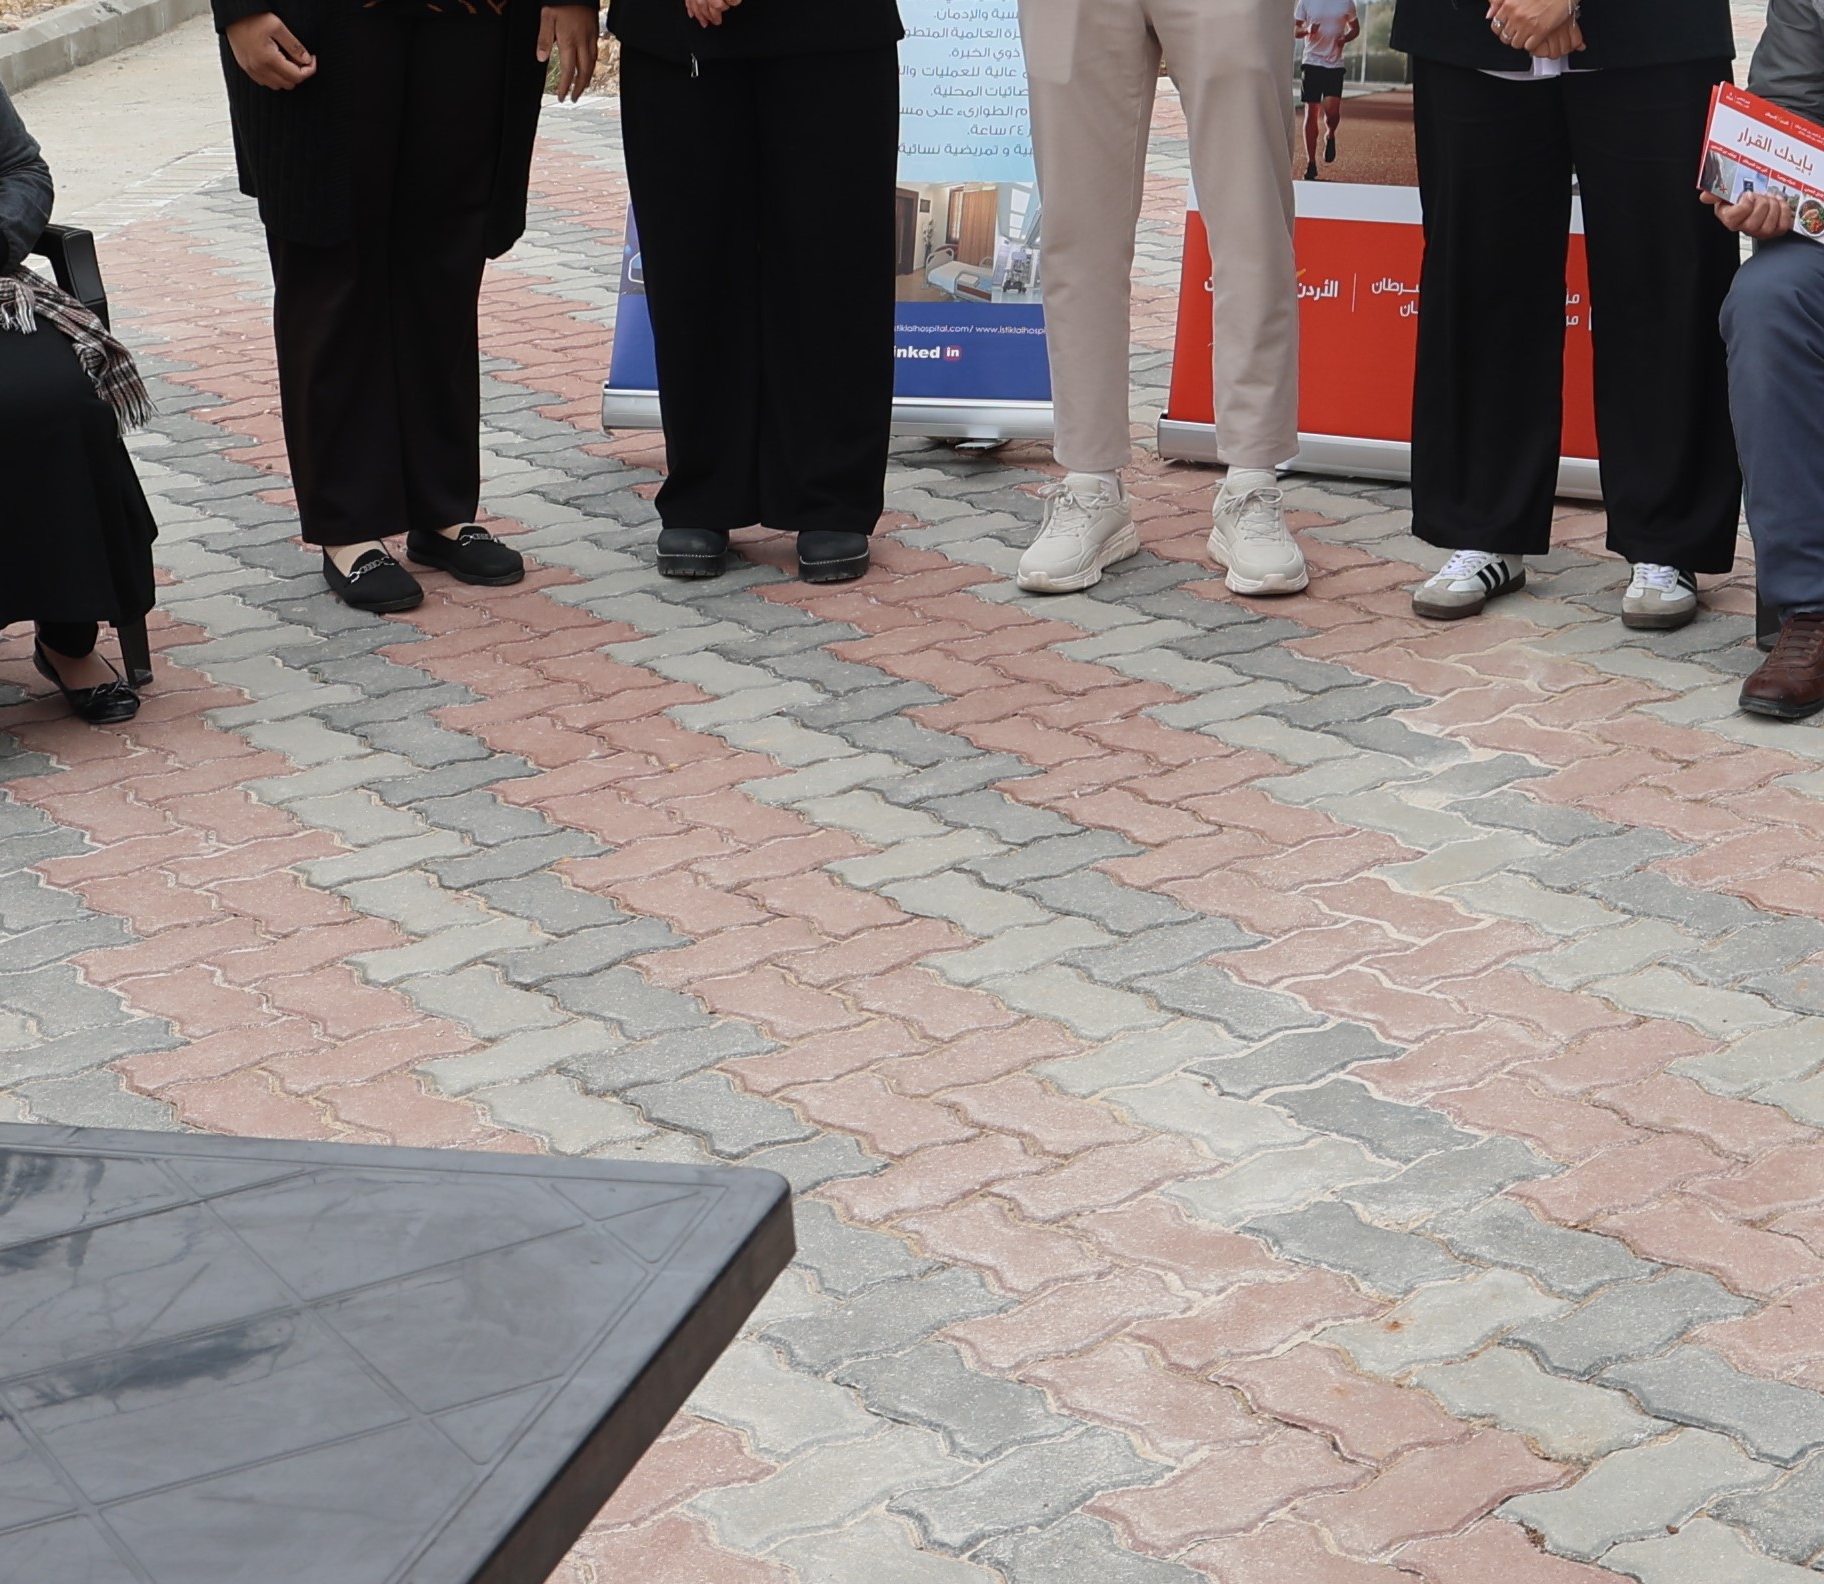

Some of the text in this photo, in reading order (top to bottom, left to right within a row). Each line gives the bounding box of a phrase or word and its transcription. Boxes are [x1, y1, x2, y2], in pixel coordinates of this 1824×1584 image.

[951, 27, 1002, 40] العالمية
[993, 48, 1020, 61] ذوي
[922, 66, 980, 78] للعمليات
[985, 66, 1017, 78] عالية
[926, 105, 954, 118] على
[1737, 127, 1772, 153] القرار
[944, 144, 998, 156] تمريضية
[1774, 146, 1813, 176] بإيدك
[1297, 278, 1339, 301] الأردن
[894, 346, 940, 359] inked
